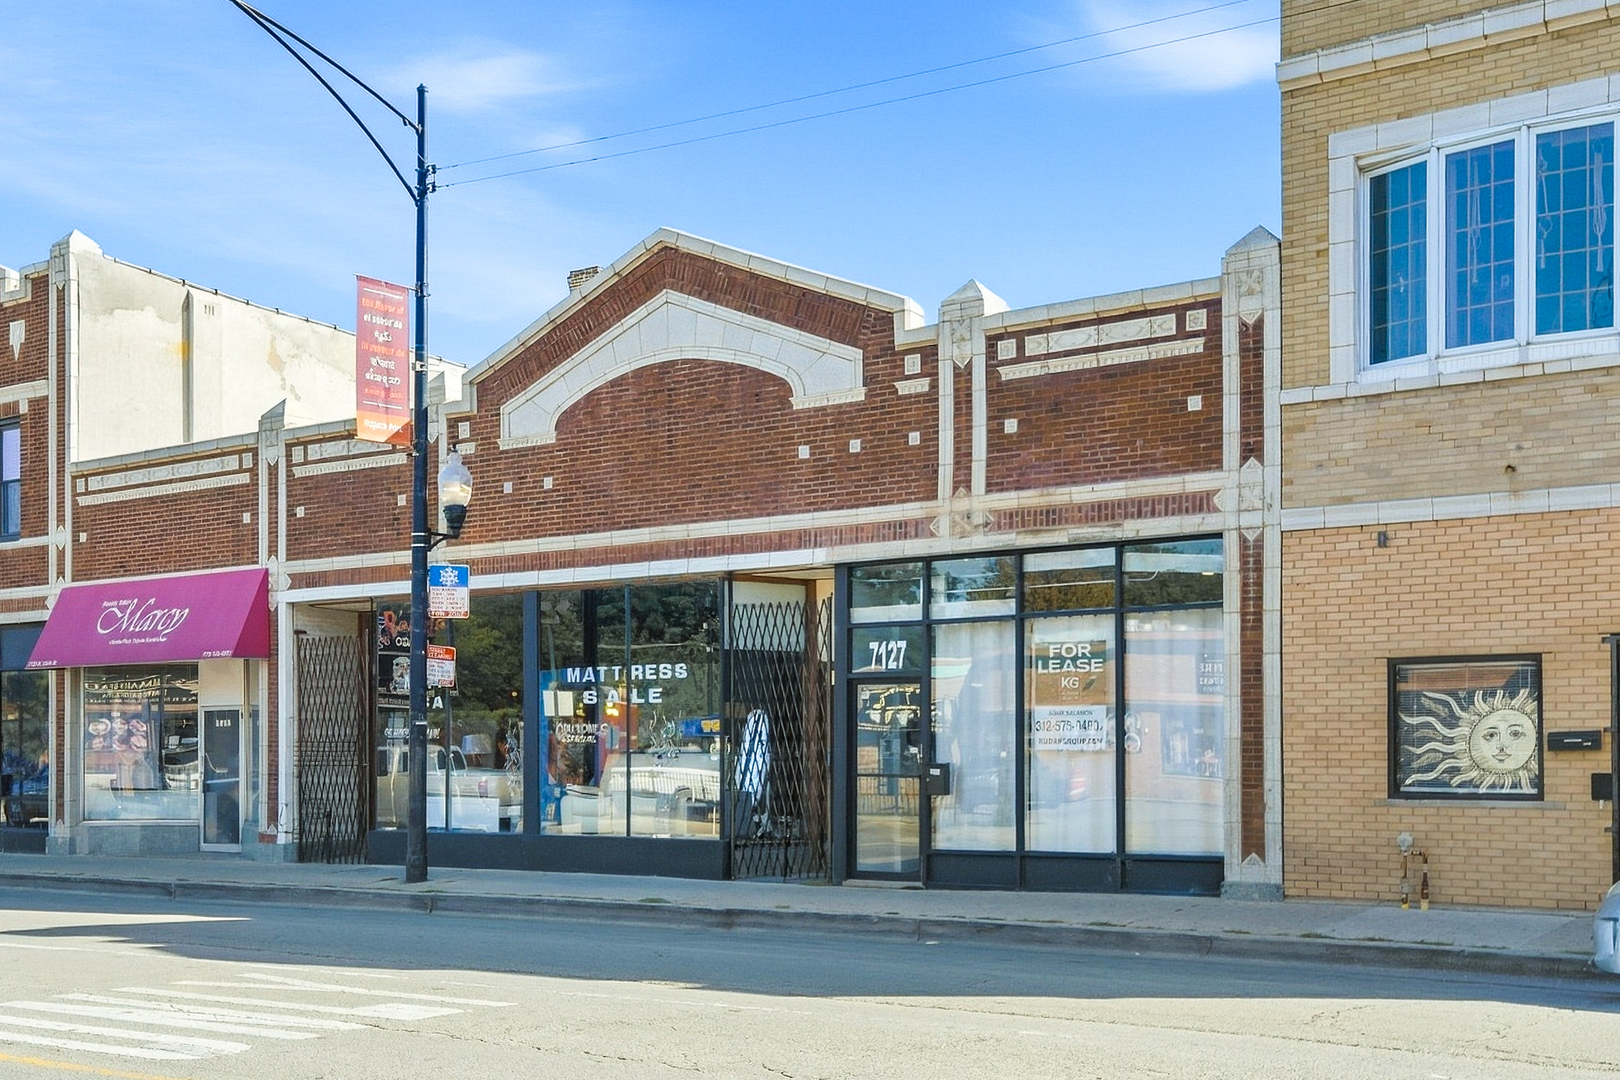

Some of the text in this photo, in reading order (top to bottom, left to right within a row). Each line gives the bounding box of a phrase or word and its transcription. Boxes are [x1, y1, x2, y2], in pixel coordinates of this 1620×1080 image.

[363, 314, 371, 322] el
[97, 597, 190, 642] Marcy
[869, 640, 907, 669] 7127
[1049, 643, 1091, 658] FOR
[1037, 659, 1104, 674] LEASE
[1061, 676, 1079, 688] KG
[583, 687, 663, 705] SALE
